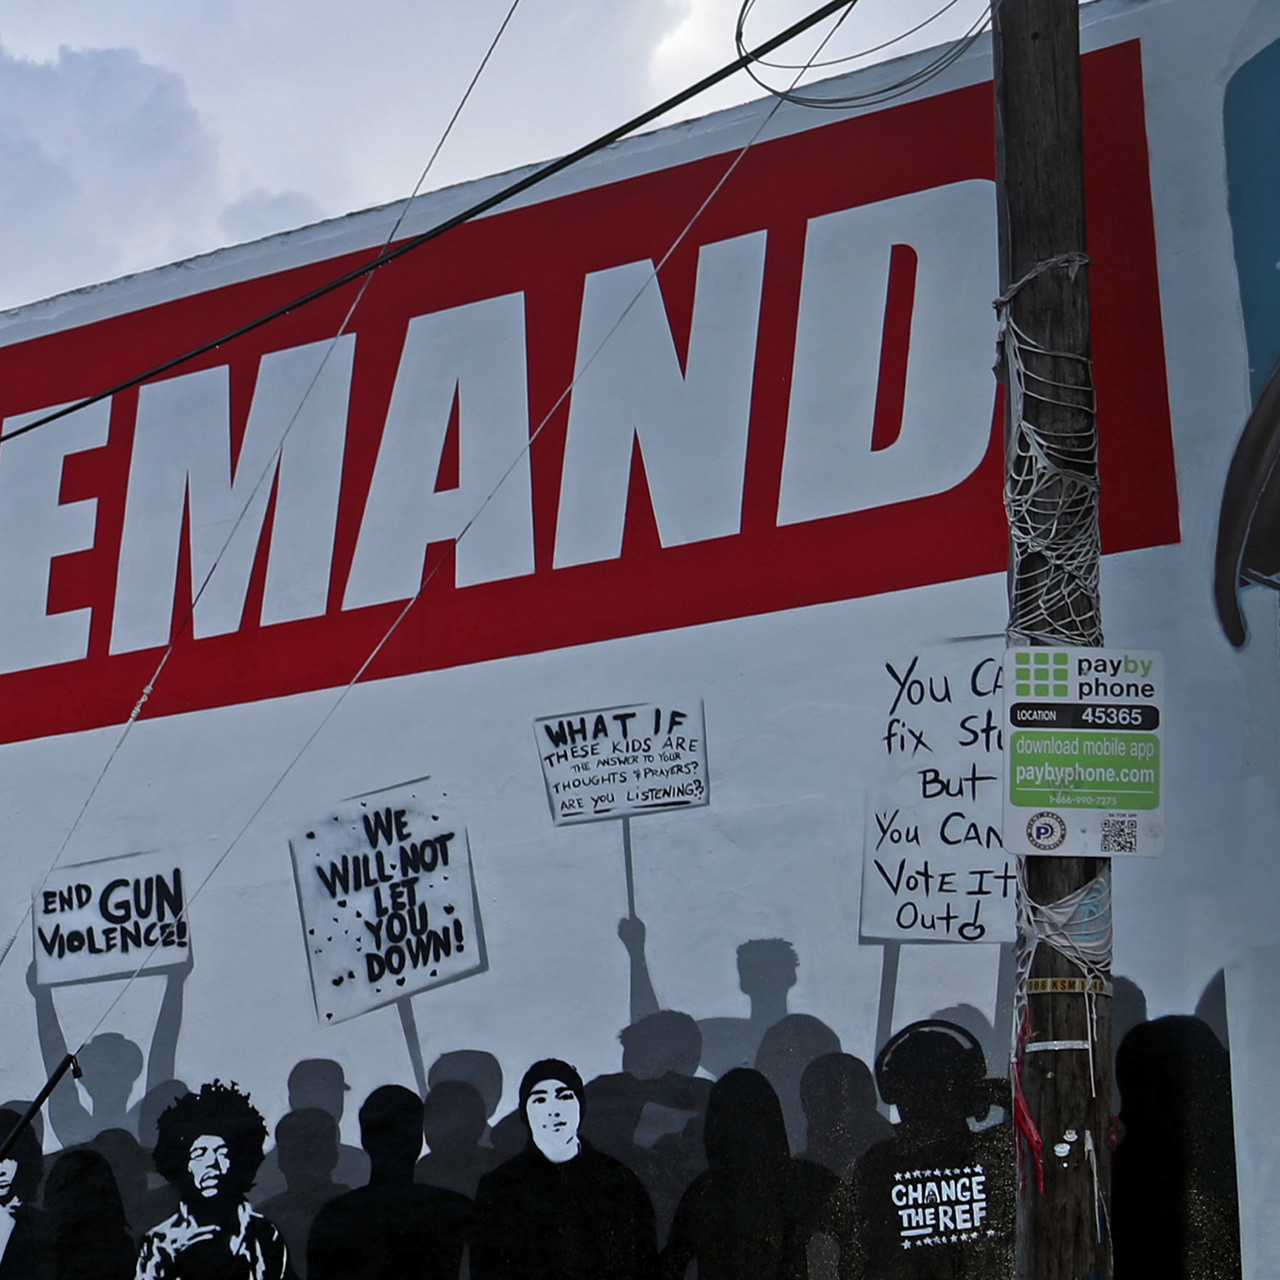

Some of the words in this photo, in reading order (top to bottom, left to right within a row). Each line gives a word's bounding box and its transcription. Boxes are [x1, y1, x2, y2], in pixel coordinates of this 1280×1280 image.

[885, 656, 952, 716] You
[1078, 678, 1155, 700] phone
[544, 713, 636, 748] WHAT
[654, 708, 687, 736] IF
[1017, 710, 1057, 721] LOCATION
[1082, 708, 1142, 725] 45365
[544, 742, 600, 767] THESE
[612, 738, 652, 754] KIDS
[662, 736, 698, 752] ARE
[881, 718, 933, 757] fix
[1016, 736, 1079, 754] download
[1083, 737, 1126, 756] mobile
[1130, 742, 1154, 760] app
[553, 772, 627, 794] THOUGHTS
[644, 761, 699, 780] PRAYERS?
[571, 762, 591, 773] THE
[596, 755, 638, 768] ANSWER
[642, 754, 655, 764] TO
[658, 751, 681, 763] YOUR
[1016, 762, 1154, 785] paybyphone.com
[917, 763, 997, 801] But
[560, 798, 584, 811] ARE
[363, 807, 412, 849] WE
[875, 809, 920, 851] You
[316, 850, 394, 899] WILL
[400, 832, 455, 877] NOT
[43, 883, 92, 914] END
[99, 867, 183, 924] GUN
[374, 877, 419, 918] LET
[38, 920, 187, 959] VIOLENCE!
[365, 902, 428, 951] YOU
[365, 918, 464, 983] DOWN!
[891, 1175, 986, 1206] CHANGE
[898, 1208, 936, 1228] THE
[939, 1201, 986, 1231] REF
